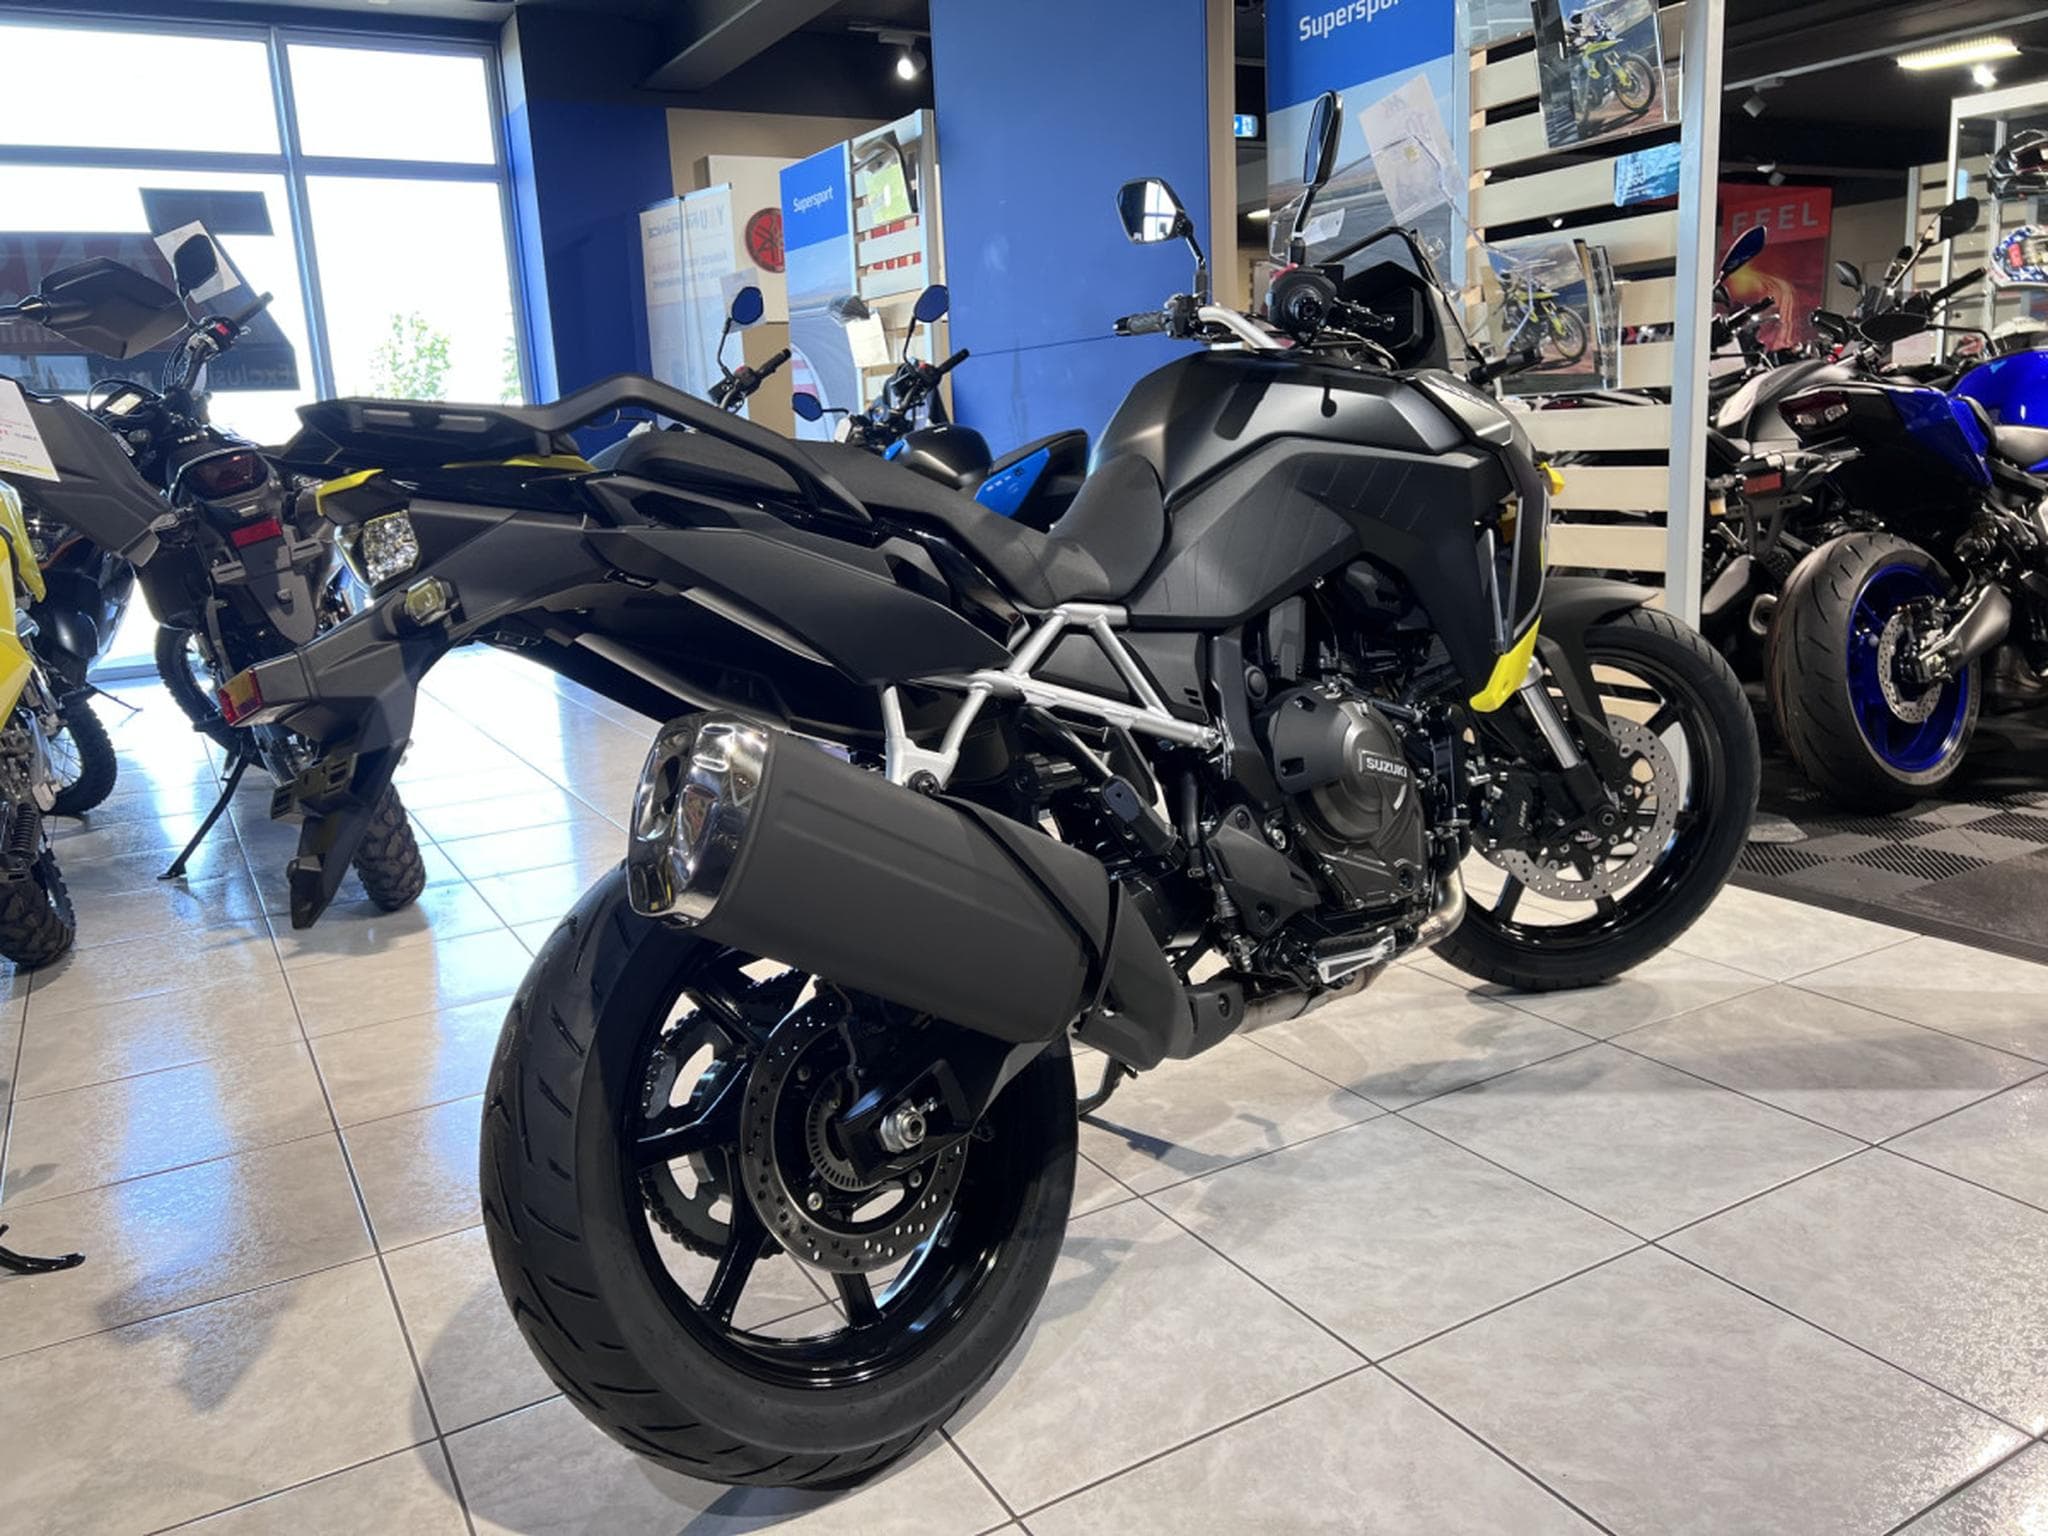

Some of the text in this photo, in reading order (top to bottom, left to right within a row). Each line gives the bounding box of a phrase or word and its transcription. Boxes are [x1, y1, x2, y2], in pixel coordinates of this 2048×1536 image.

[1299, 0, 1399, 41] Superspo
[793, 185, 834, 214] Supersport
[1732, 202, 1819, 237] FEEL
[1366, 757, 1408, 778] SUZUKI
